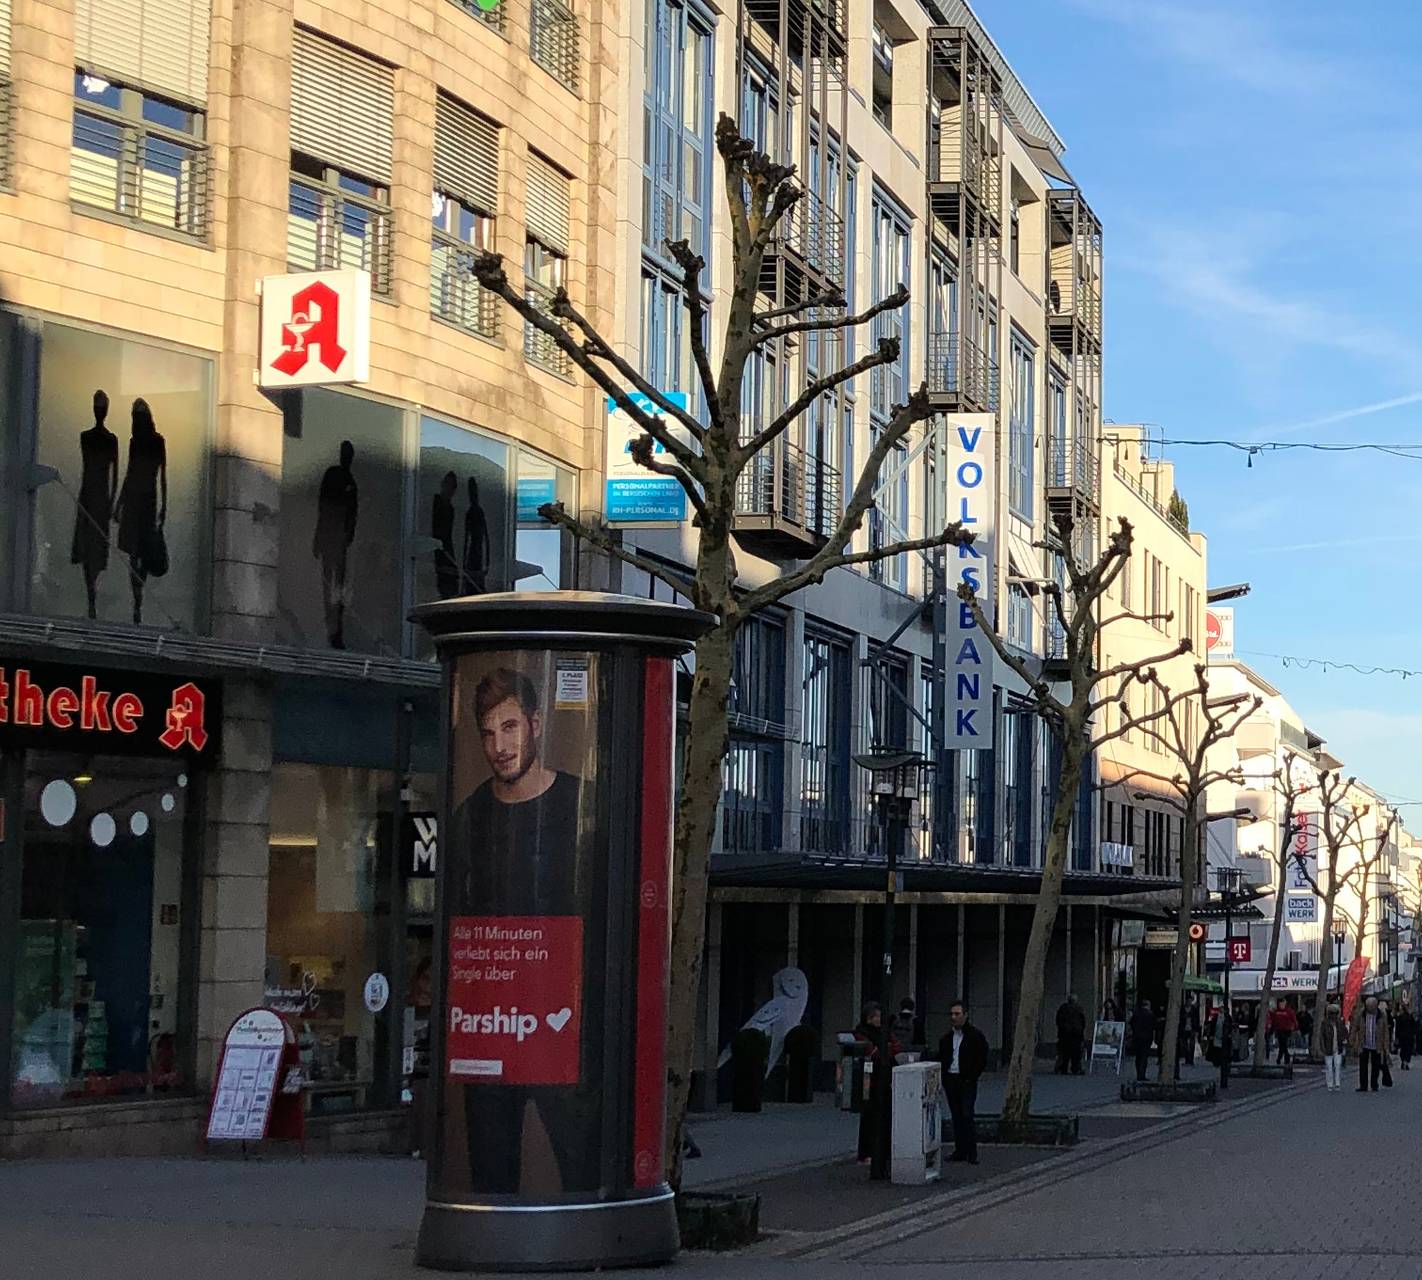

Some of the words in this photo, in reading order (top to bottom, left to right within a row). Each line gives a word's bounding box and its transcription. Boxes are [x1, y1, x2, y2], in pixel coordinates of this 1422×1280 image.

[956, 426, 983, 737] VOLKSBANK
[1288, 898, 1314, 908] back
[1288, 909, 1314, 918] WERK
[454, 928, 472, 940] Alle
[485, 927, 543, 940] Minuten
[453, 946, 490, 960] verliebt
[493, 946, 520, 960] sich
[524, 947, 549, 960] ein
[452, 966, 482, 983] Single
[484, 967, 517, 981] über
[1292, 975, 1318, 986] WERK
[450, 1006, 538, 1042] Parship
